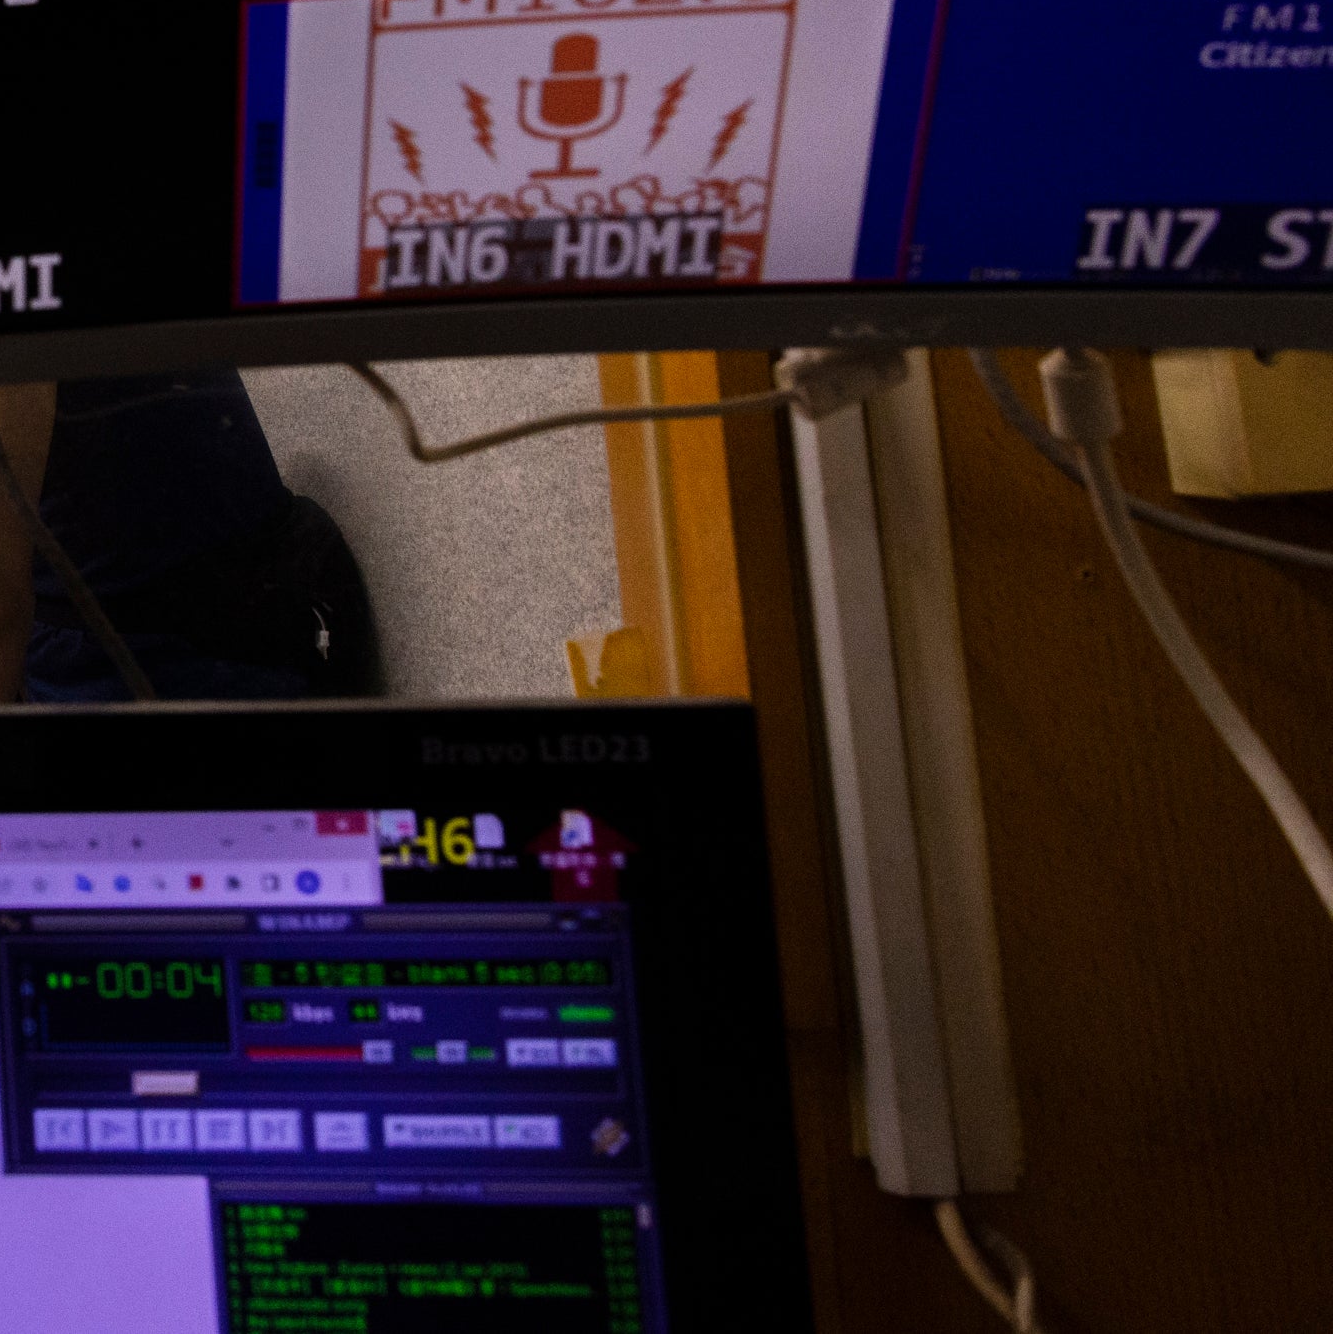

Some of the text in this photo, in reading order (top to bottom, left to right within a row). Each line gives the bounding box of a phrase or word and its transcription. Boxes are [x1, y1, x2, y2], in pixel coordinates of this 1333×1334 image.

[389, 217, 720, 290] IN6 HDMI
[1077, 208, 1220, 269] IN7
